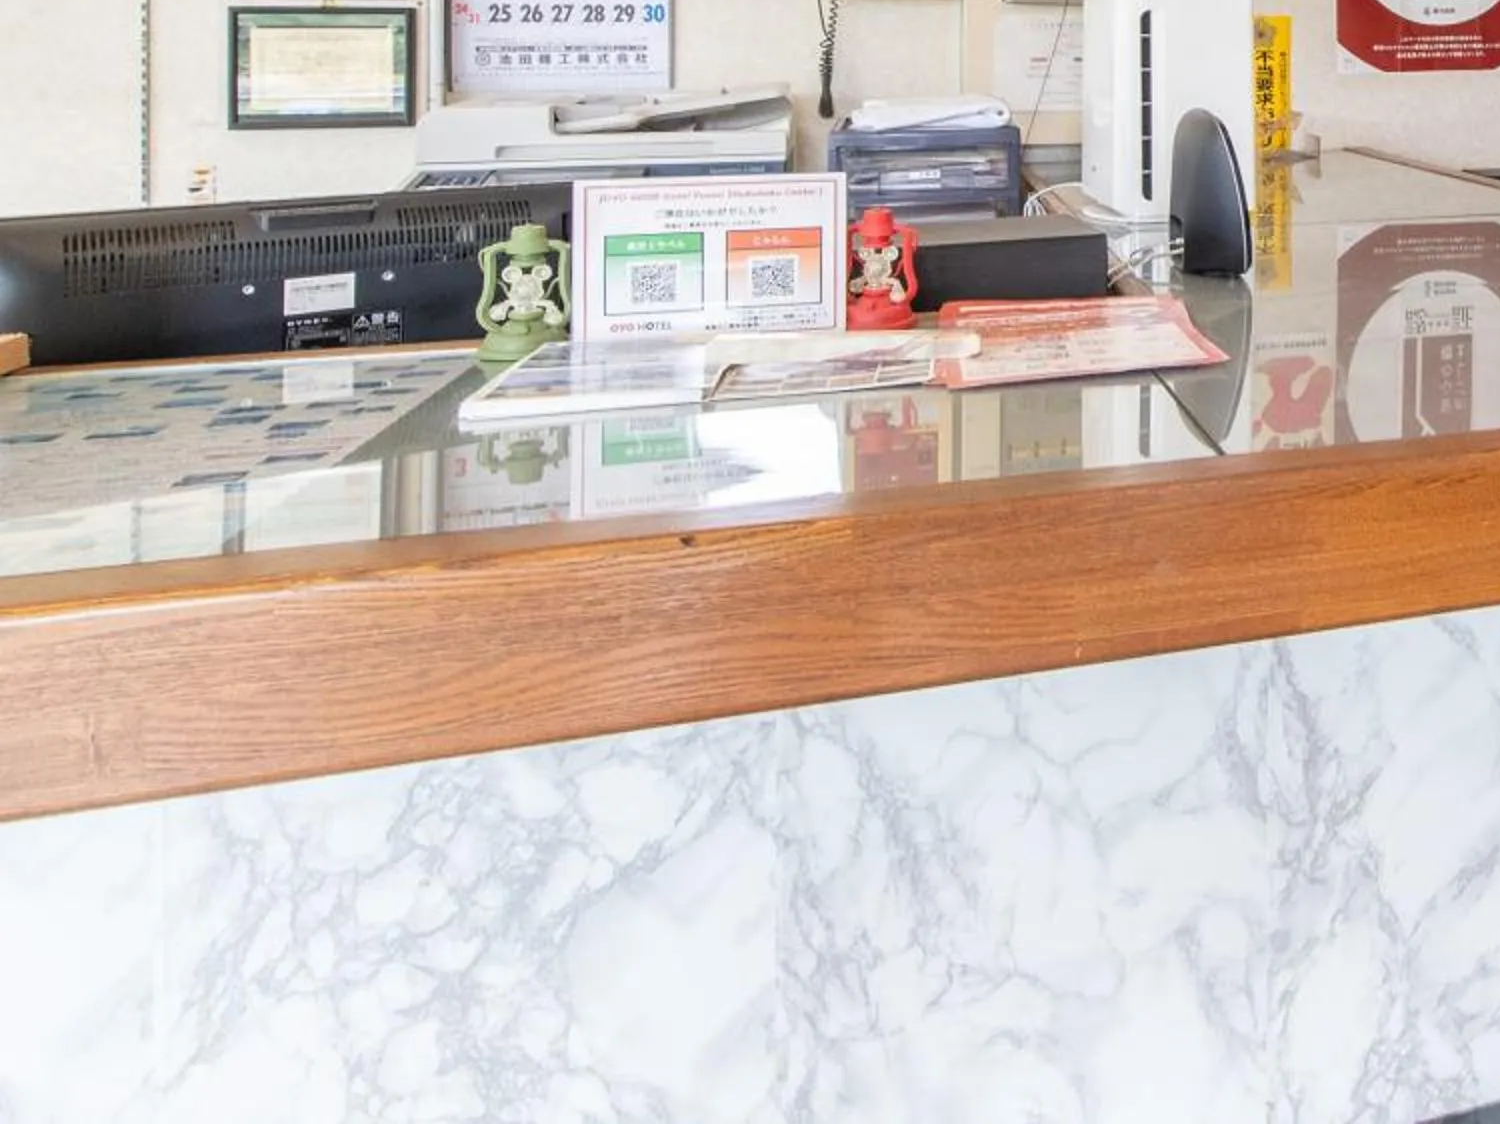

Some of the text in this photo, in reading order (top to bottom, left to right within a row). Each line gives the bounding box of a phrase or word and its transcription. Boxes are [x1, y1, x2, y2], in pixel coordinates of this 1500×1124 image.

[489, 4, 512, 22] 25
[521, 4, 542, 22] 26
[552, 5, 573, 23] 27
[583, 5, 605, 23] 28
[614, 5, 634, 22] 29
[643, 5, 664, 22] 30
